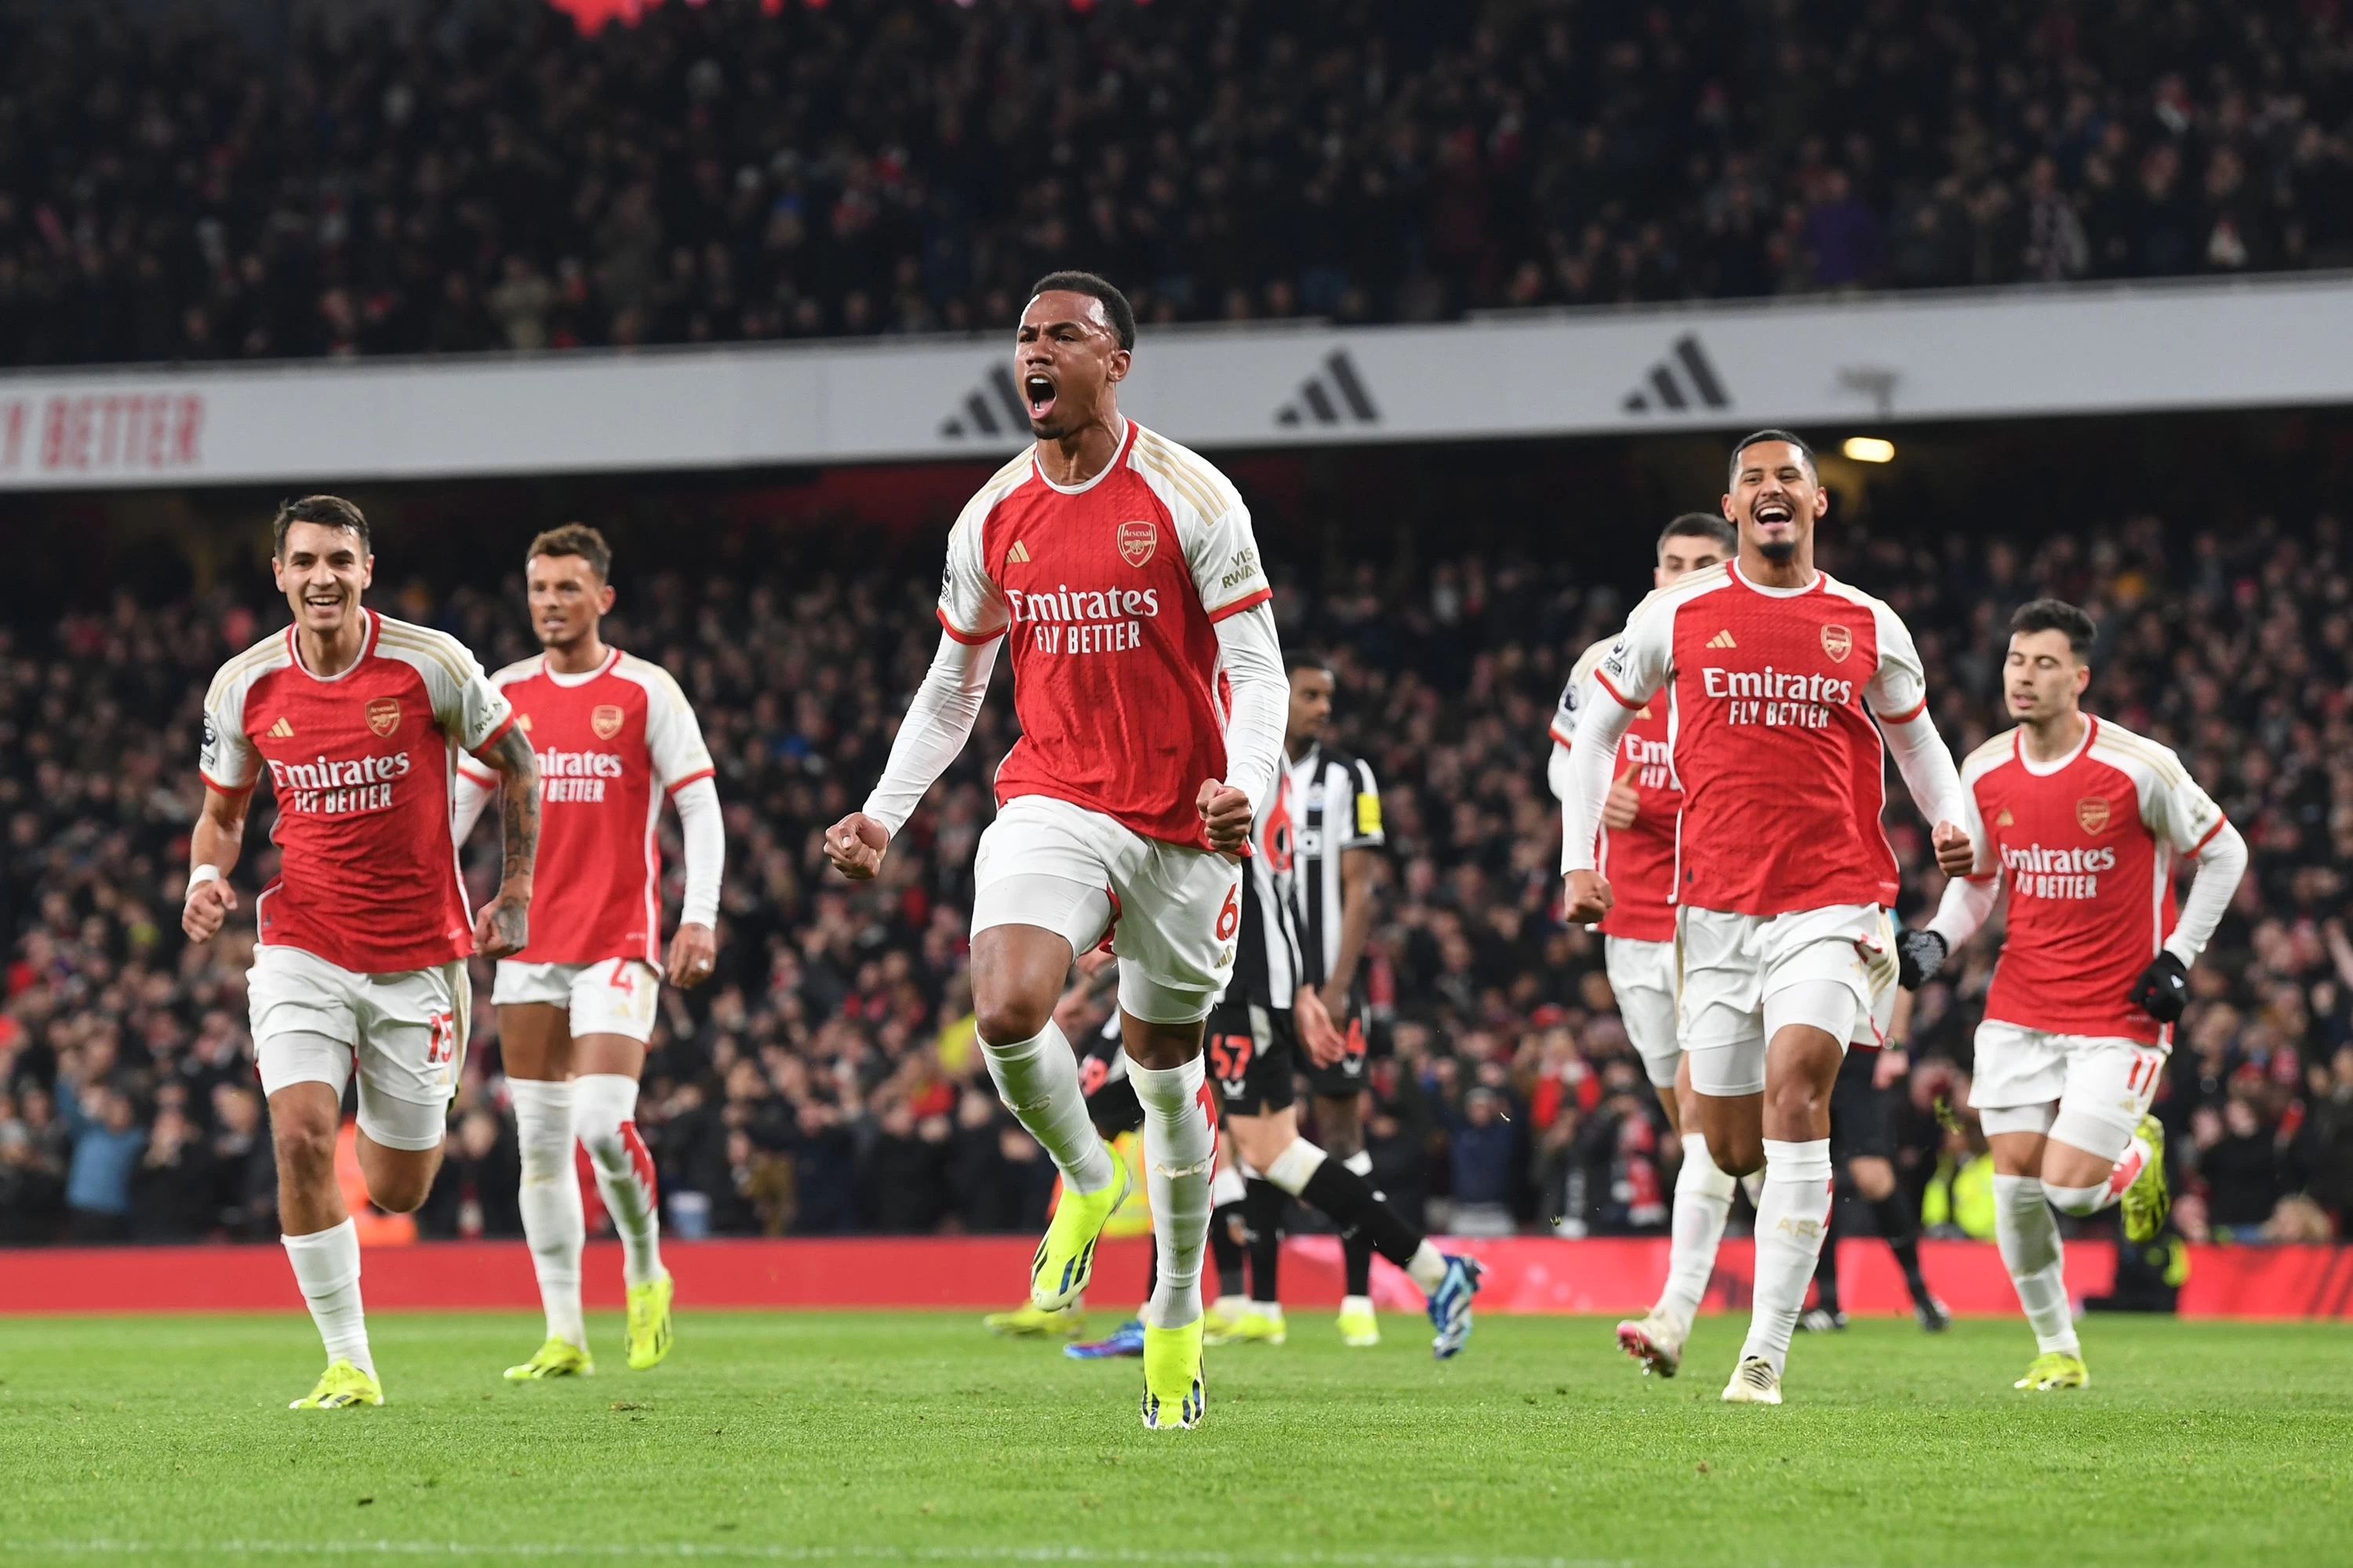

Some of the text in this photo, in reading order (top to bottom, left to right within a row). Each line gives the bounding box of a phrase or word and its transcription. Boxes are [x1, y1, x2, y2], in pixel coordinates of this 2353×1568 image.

[43, 392, 205, 469] BETTER
[1123, 529, 1151, 537] Arsenal
[1005, 584, 1158, 622] Emirates
[1035, 620, 1141, 654] FLY BETTER
[1701, 665, 1853, 705] Emirates
[1729, 700, 1830, 729] FLY BETTER
[267, 751, 410, 789] Emirates
[325, 783, 392, 813] BETTER
[547, 778, 606, 803] BETTER
[2036, 874, 2097, 900] BETTER
[1217, 882, 1238, 942] 6
[608, 956, 634, 997] 4
[427, 1012, 453, 1064] 15
[1210, 1032, 1253, 1081] 67
[2126, 1047, 2158, 1097] 11
